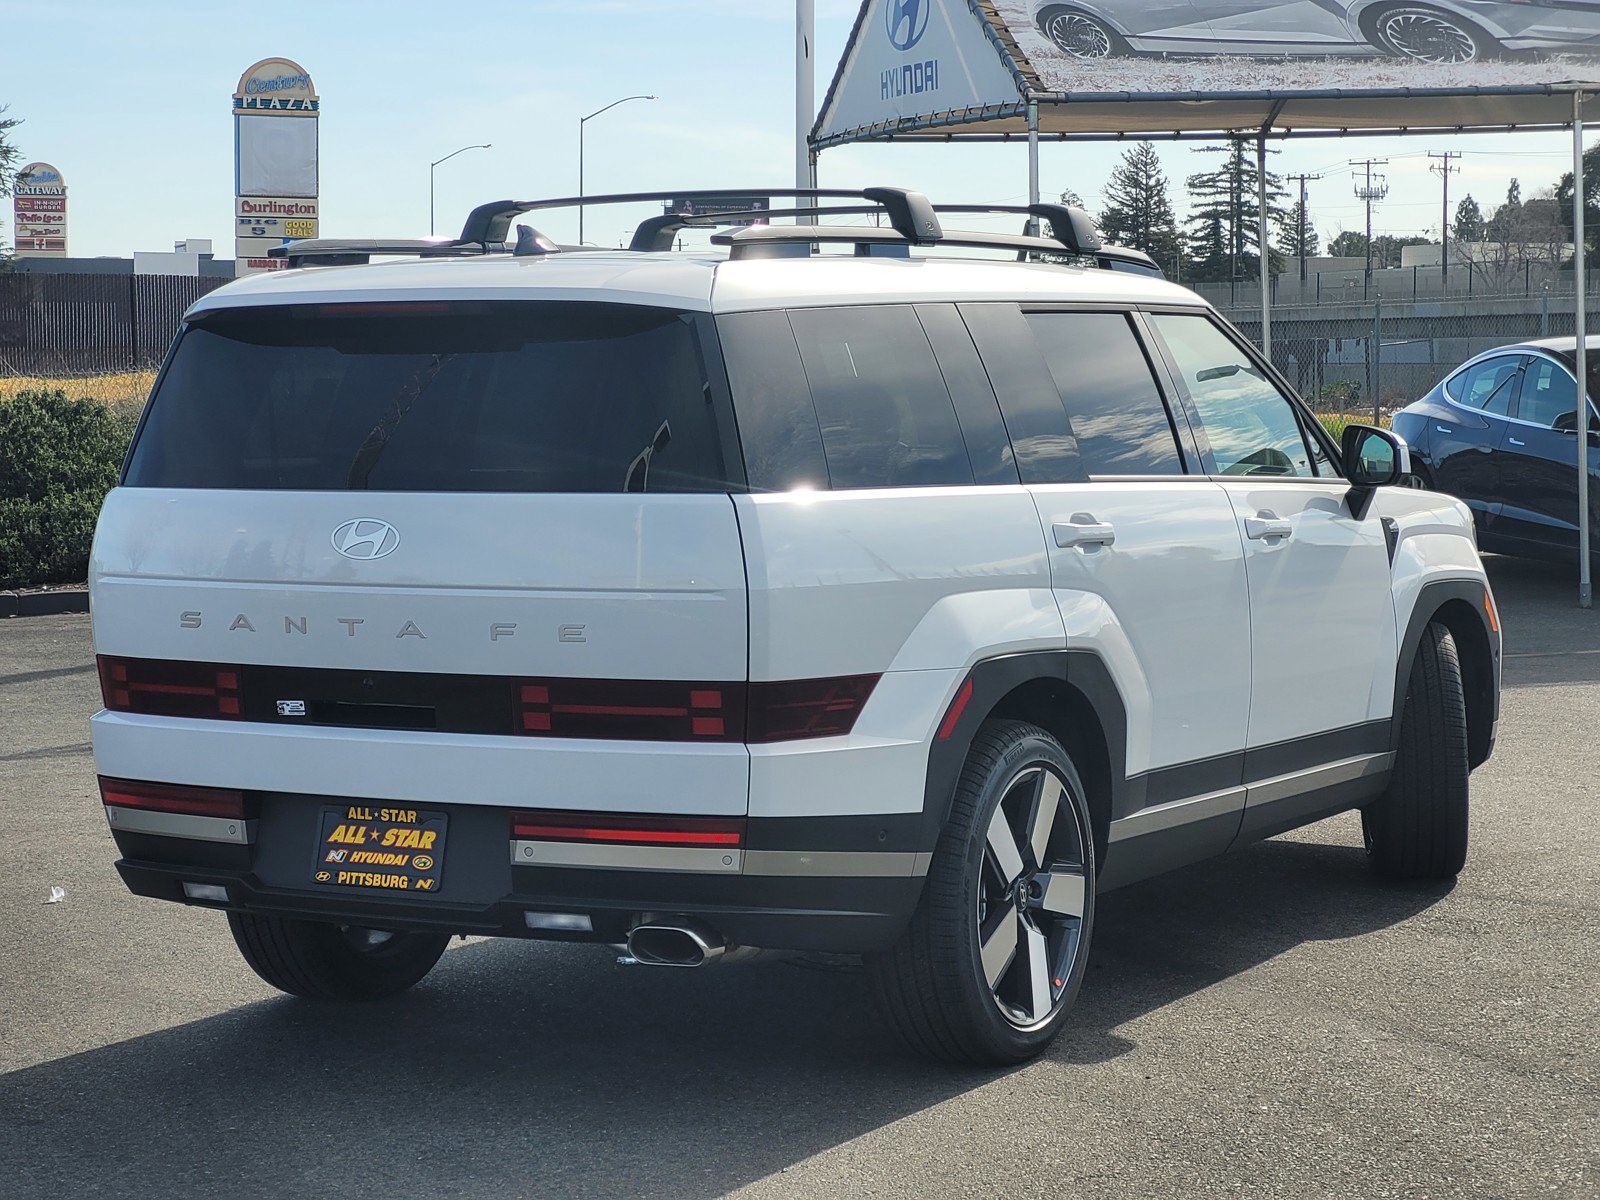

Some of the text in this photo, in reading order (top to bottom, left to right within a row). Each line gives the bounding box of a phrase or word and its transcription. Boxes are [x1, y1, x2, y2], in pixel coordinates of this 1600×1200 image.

[246, 74, 310, 94] Century
[880, 60, 939, 101] HYUNDAI
[242, 95, 313, 110] PLAZA
[16, 186, 63, 195] GATEWAY
[241, 200, 316, 216] Burlington
[43, 214, 63, 223] Loco
[285, 220, 313, 228] GOOD
[251, 226, 266, 236] 5
[285, 228, 313, 237] DEALS
[247, 259, 278, 268] HARBOR
[179, 611, 587, 644] SANTA FE
[348, 806, 417, 823] ALL STAR
[327, 824, 437, 849] ALL STAR
[349, 850, 411, 867] HYUNDAI
[337, 870, 409, 889] PITTSBURG
